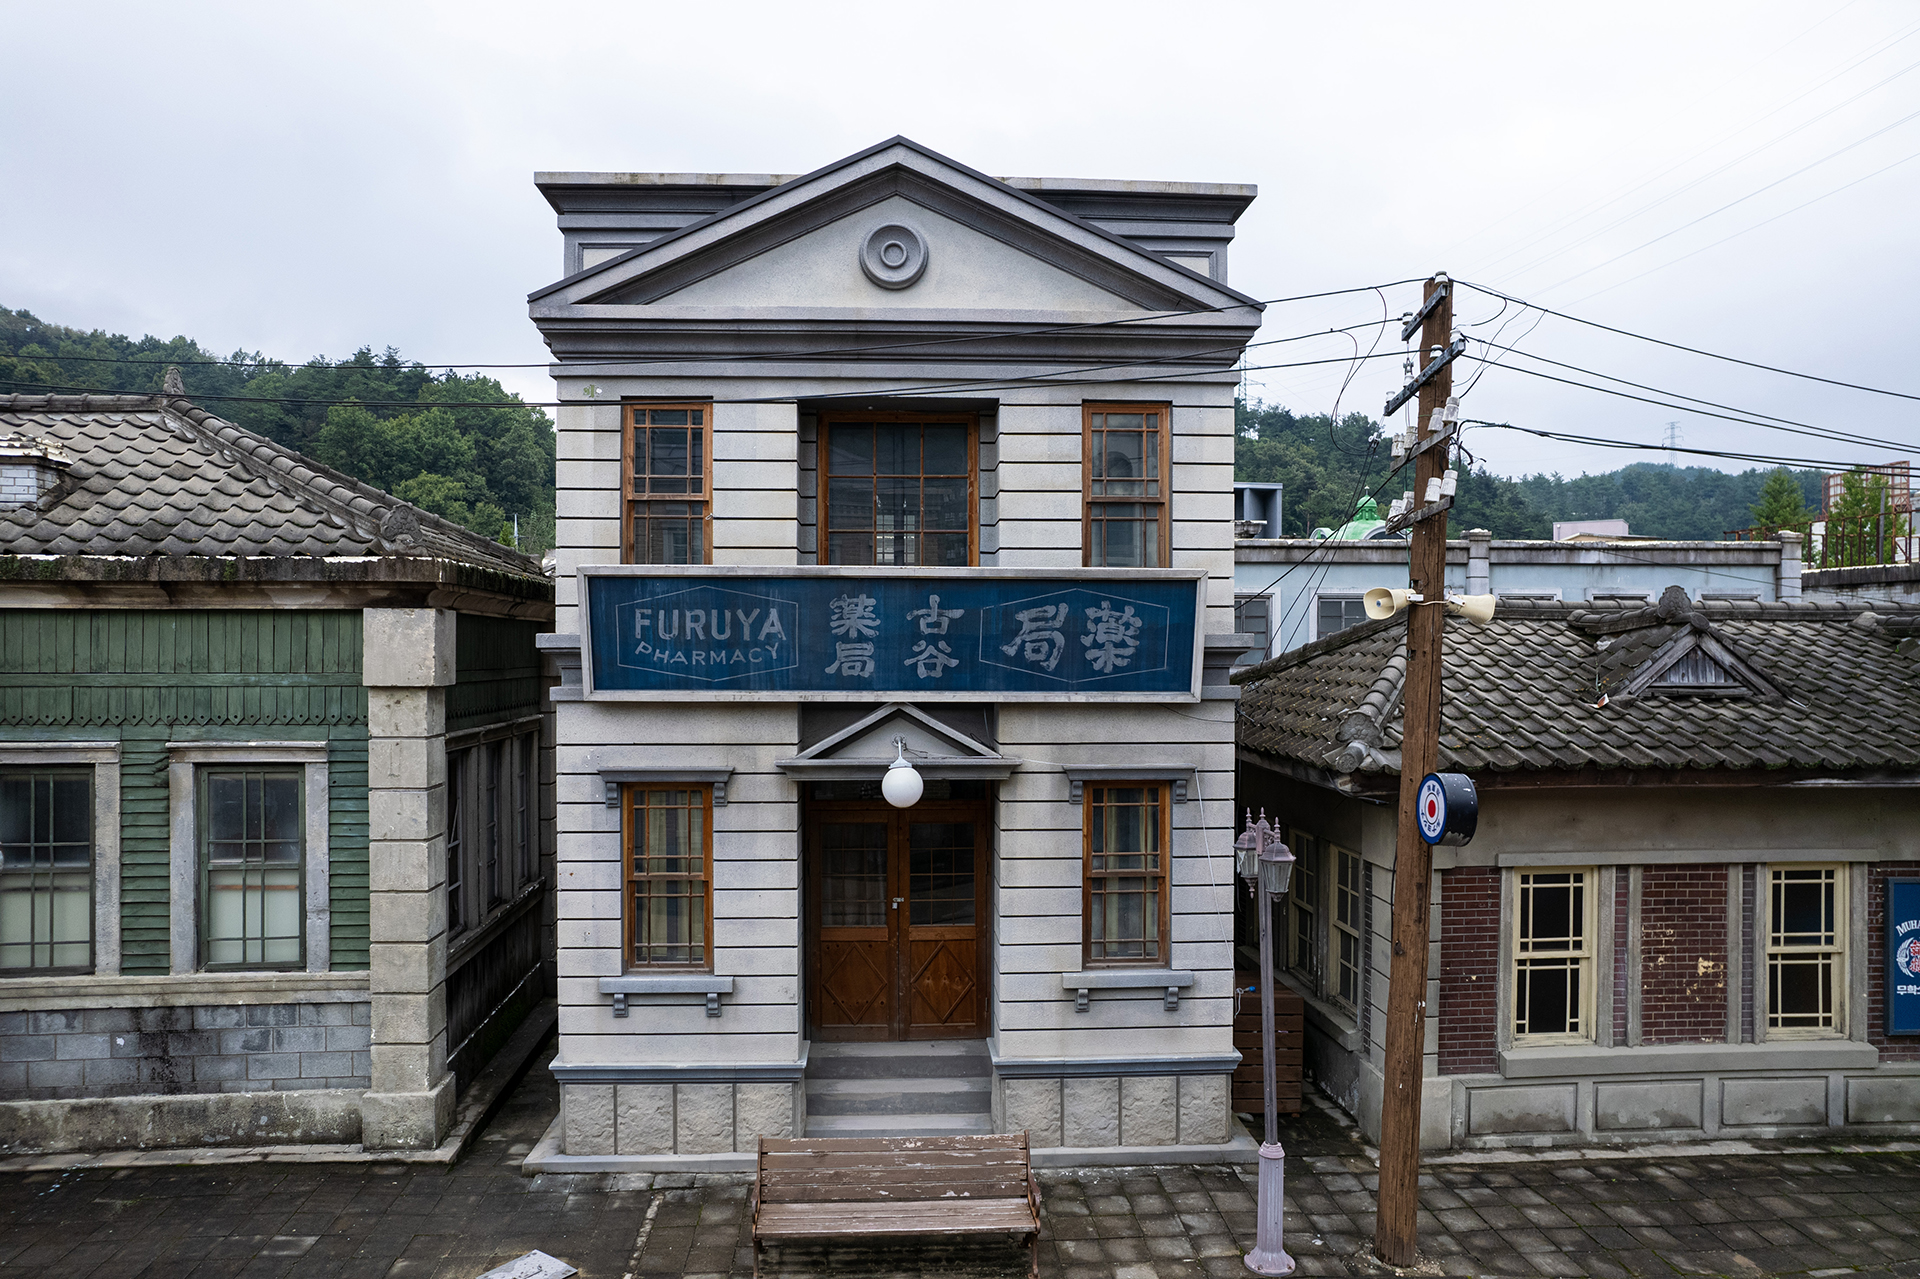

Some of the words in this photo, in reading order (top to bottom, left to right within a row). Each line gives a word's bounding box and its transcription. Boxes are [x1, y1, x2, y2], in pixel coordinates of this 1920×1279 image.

[635, 608, 787, 641] FURUYA
[904, 594, 965, 679] 古谷
[635, 641, 779, 665] PHARMACY
